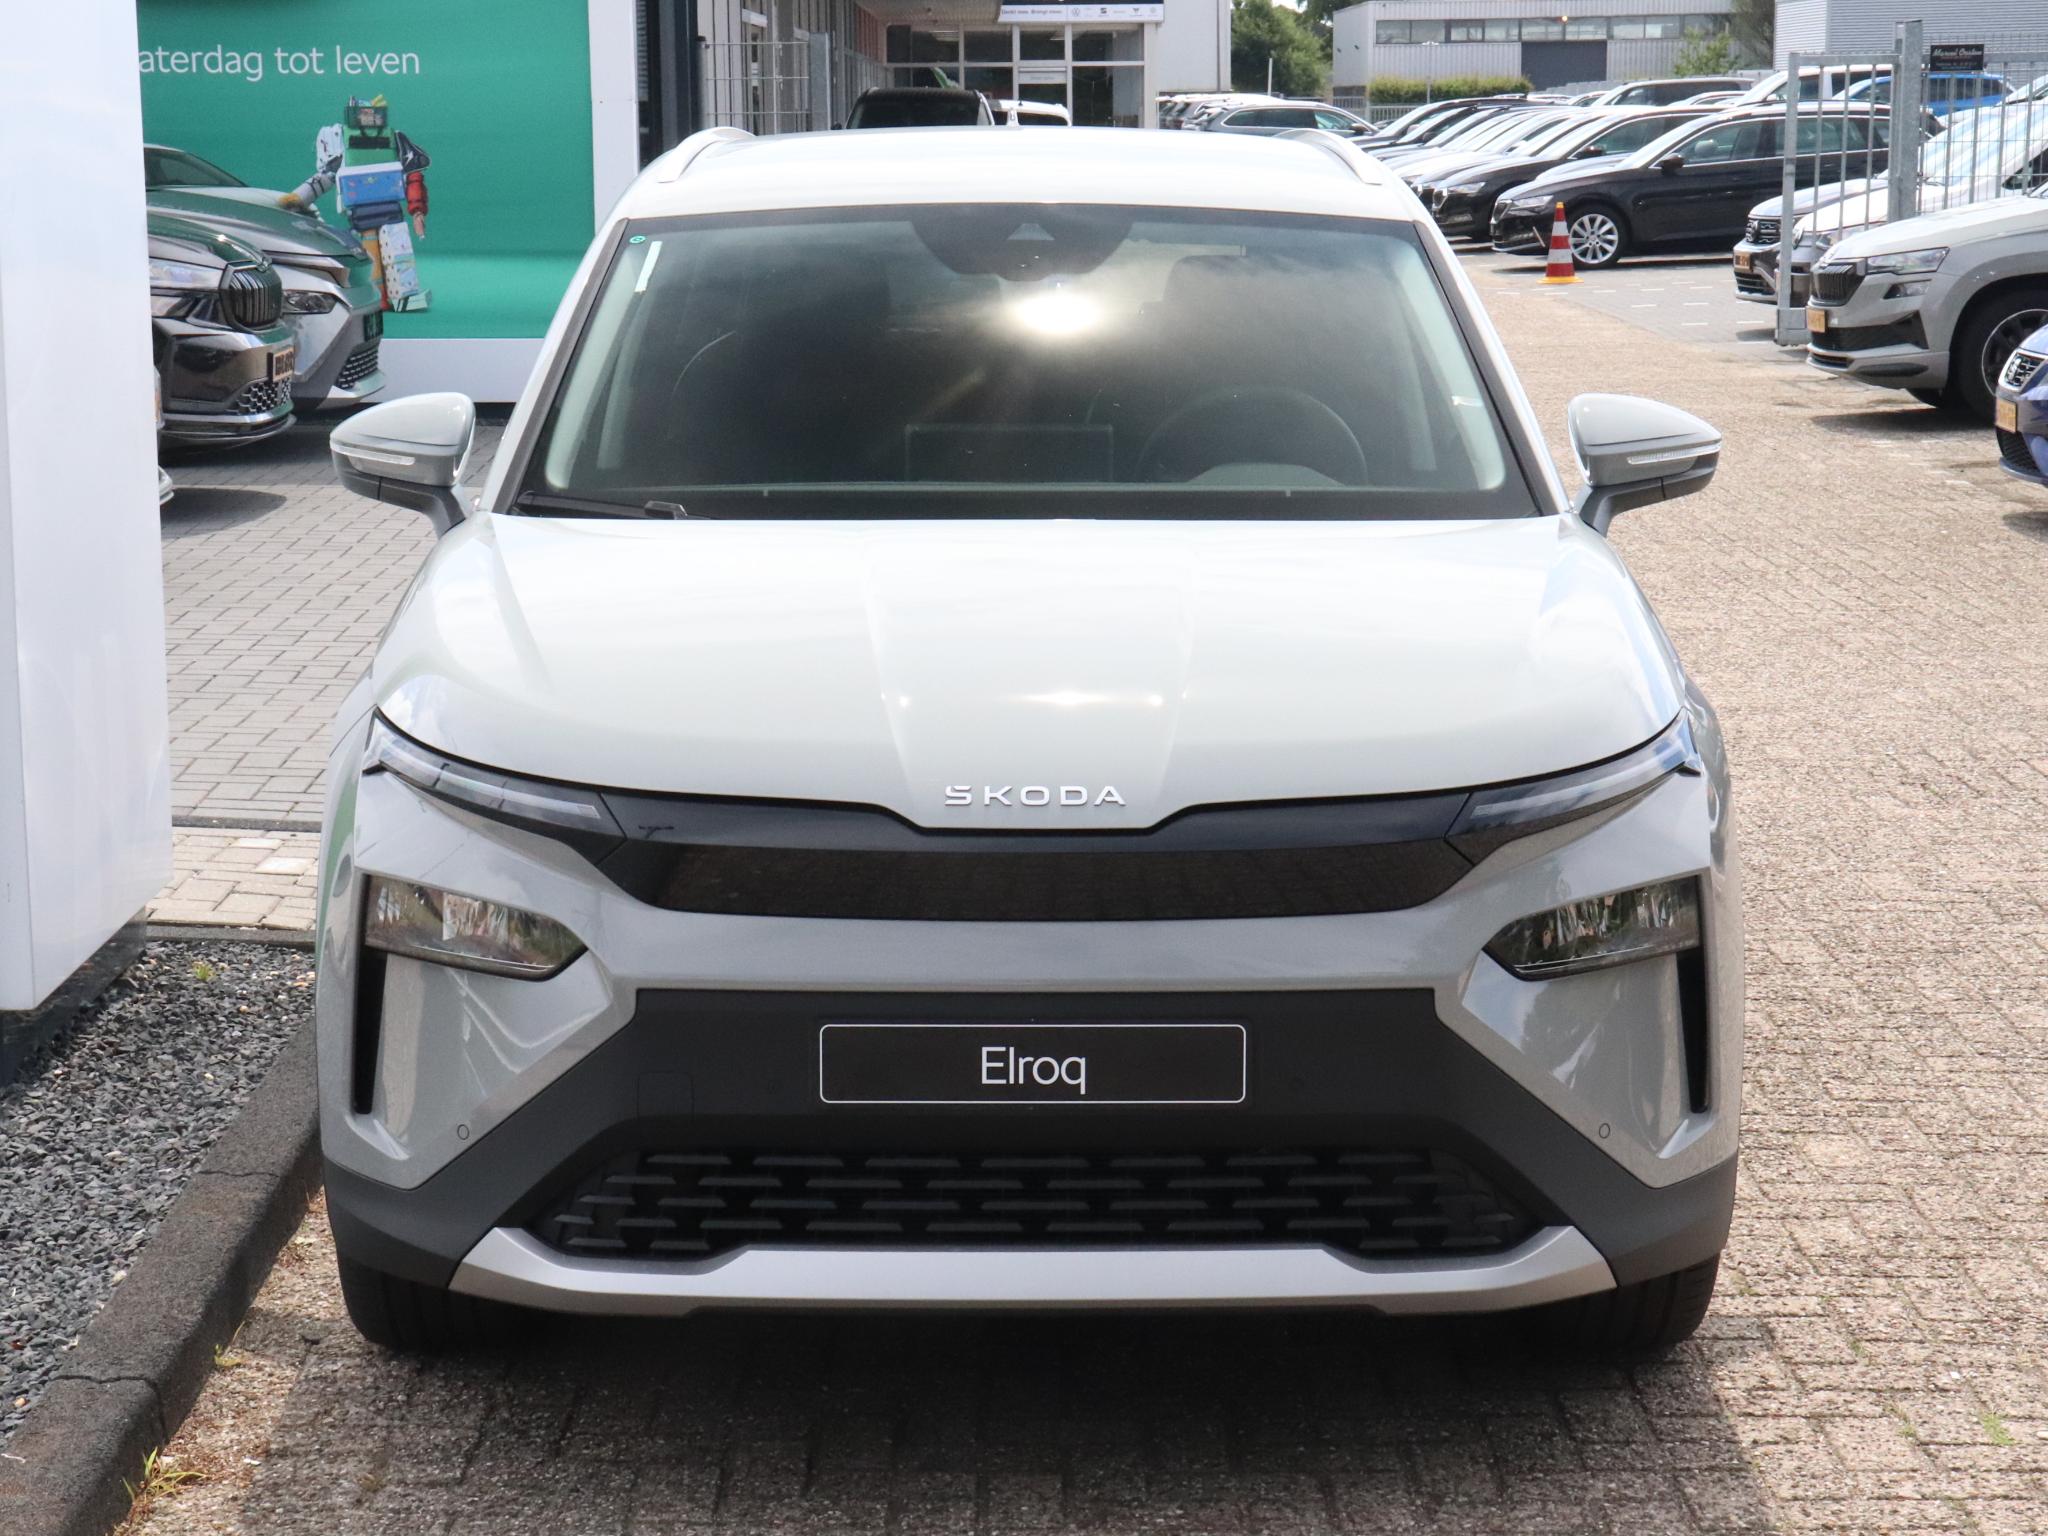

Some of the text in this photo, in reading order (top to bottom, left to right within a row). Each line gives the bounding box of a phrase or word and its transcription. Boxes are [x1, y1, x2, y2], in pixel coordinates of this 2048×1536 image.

[138, 45, 420, 82] aterdag tot leven
[944, 785, 1127, 807] SKODA
[981, 1046, 1086, 1095] Elroq
